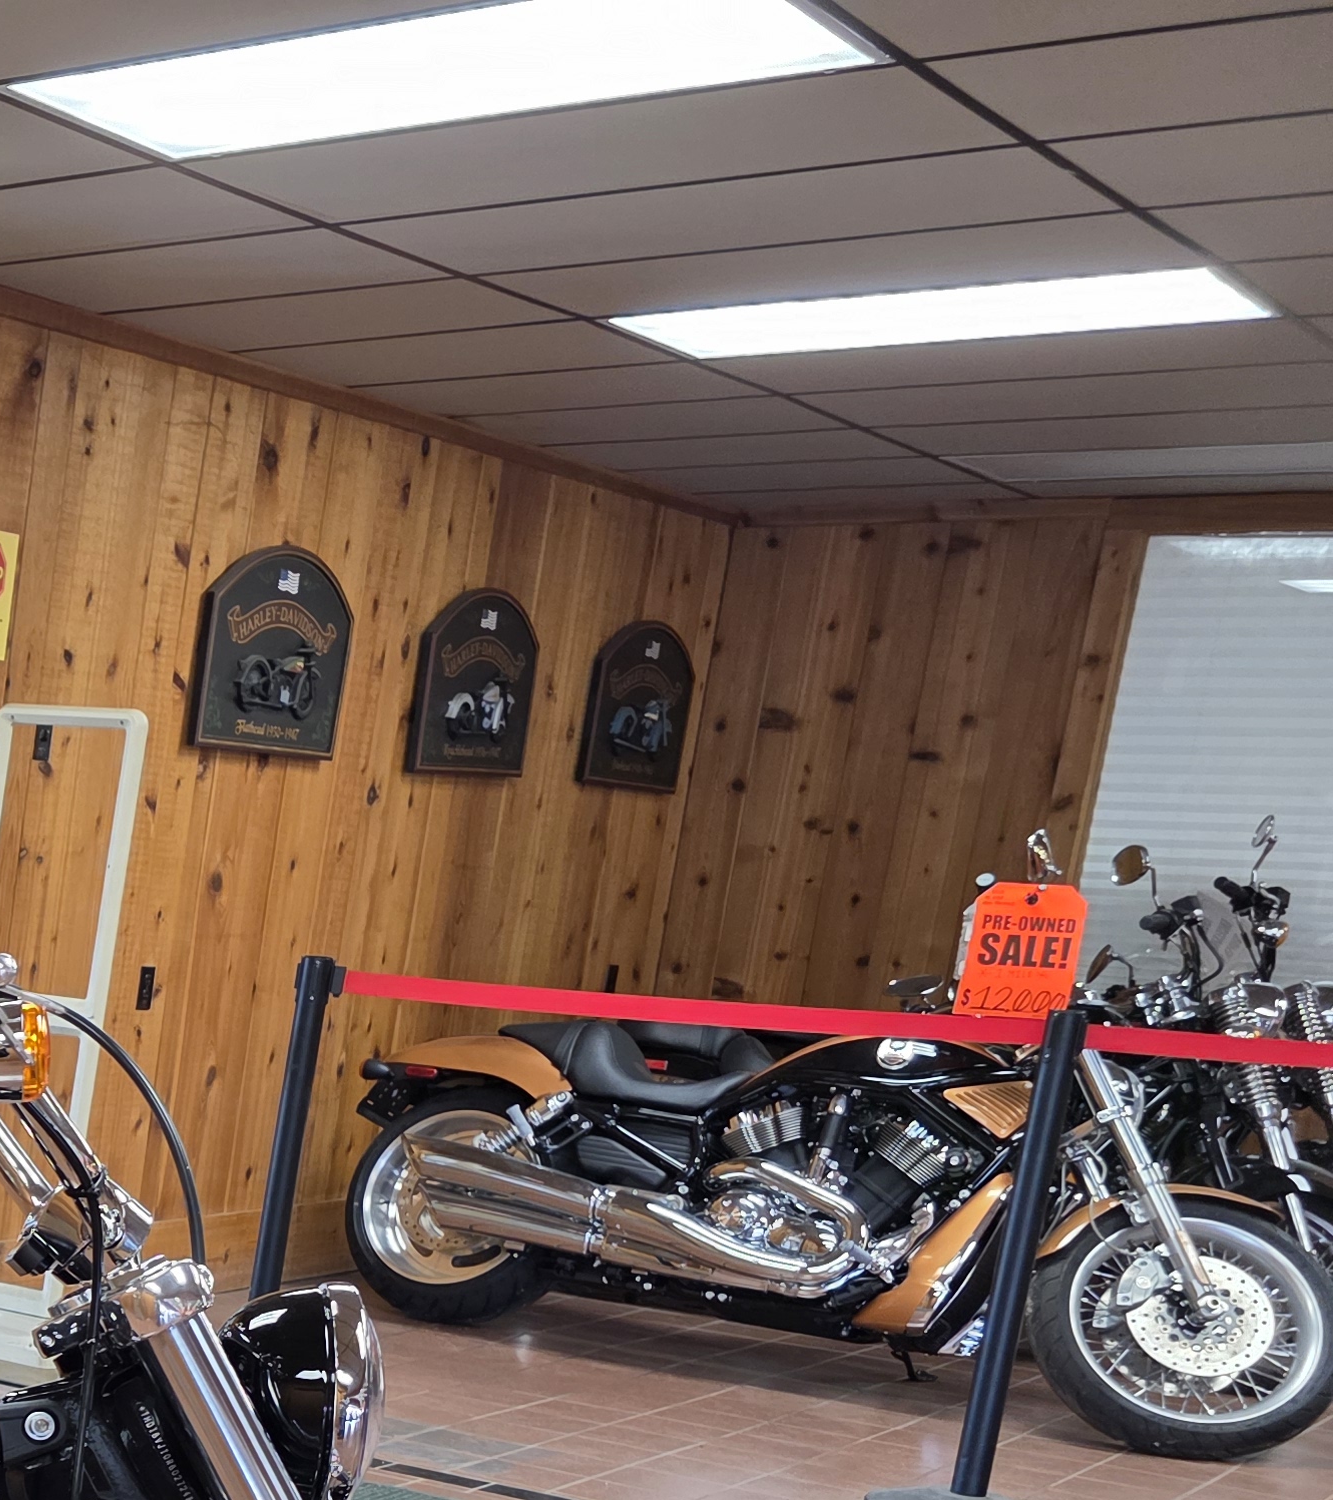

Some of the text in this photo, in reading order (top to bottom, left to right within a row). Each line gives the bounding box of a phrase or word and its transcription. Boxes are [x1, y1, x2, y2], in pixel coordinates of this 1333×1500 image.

[238, 605, 325, 651] HARLEY-DAVIDSON
[234, 718, 265, 736] Flathead
[982, 914, 1076, 933] PRE-OWNED
[978, 932, 1072, 969] SALE!
